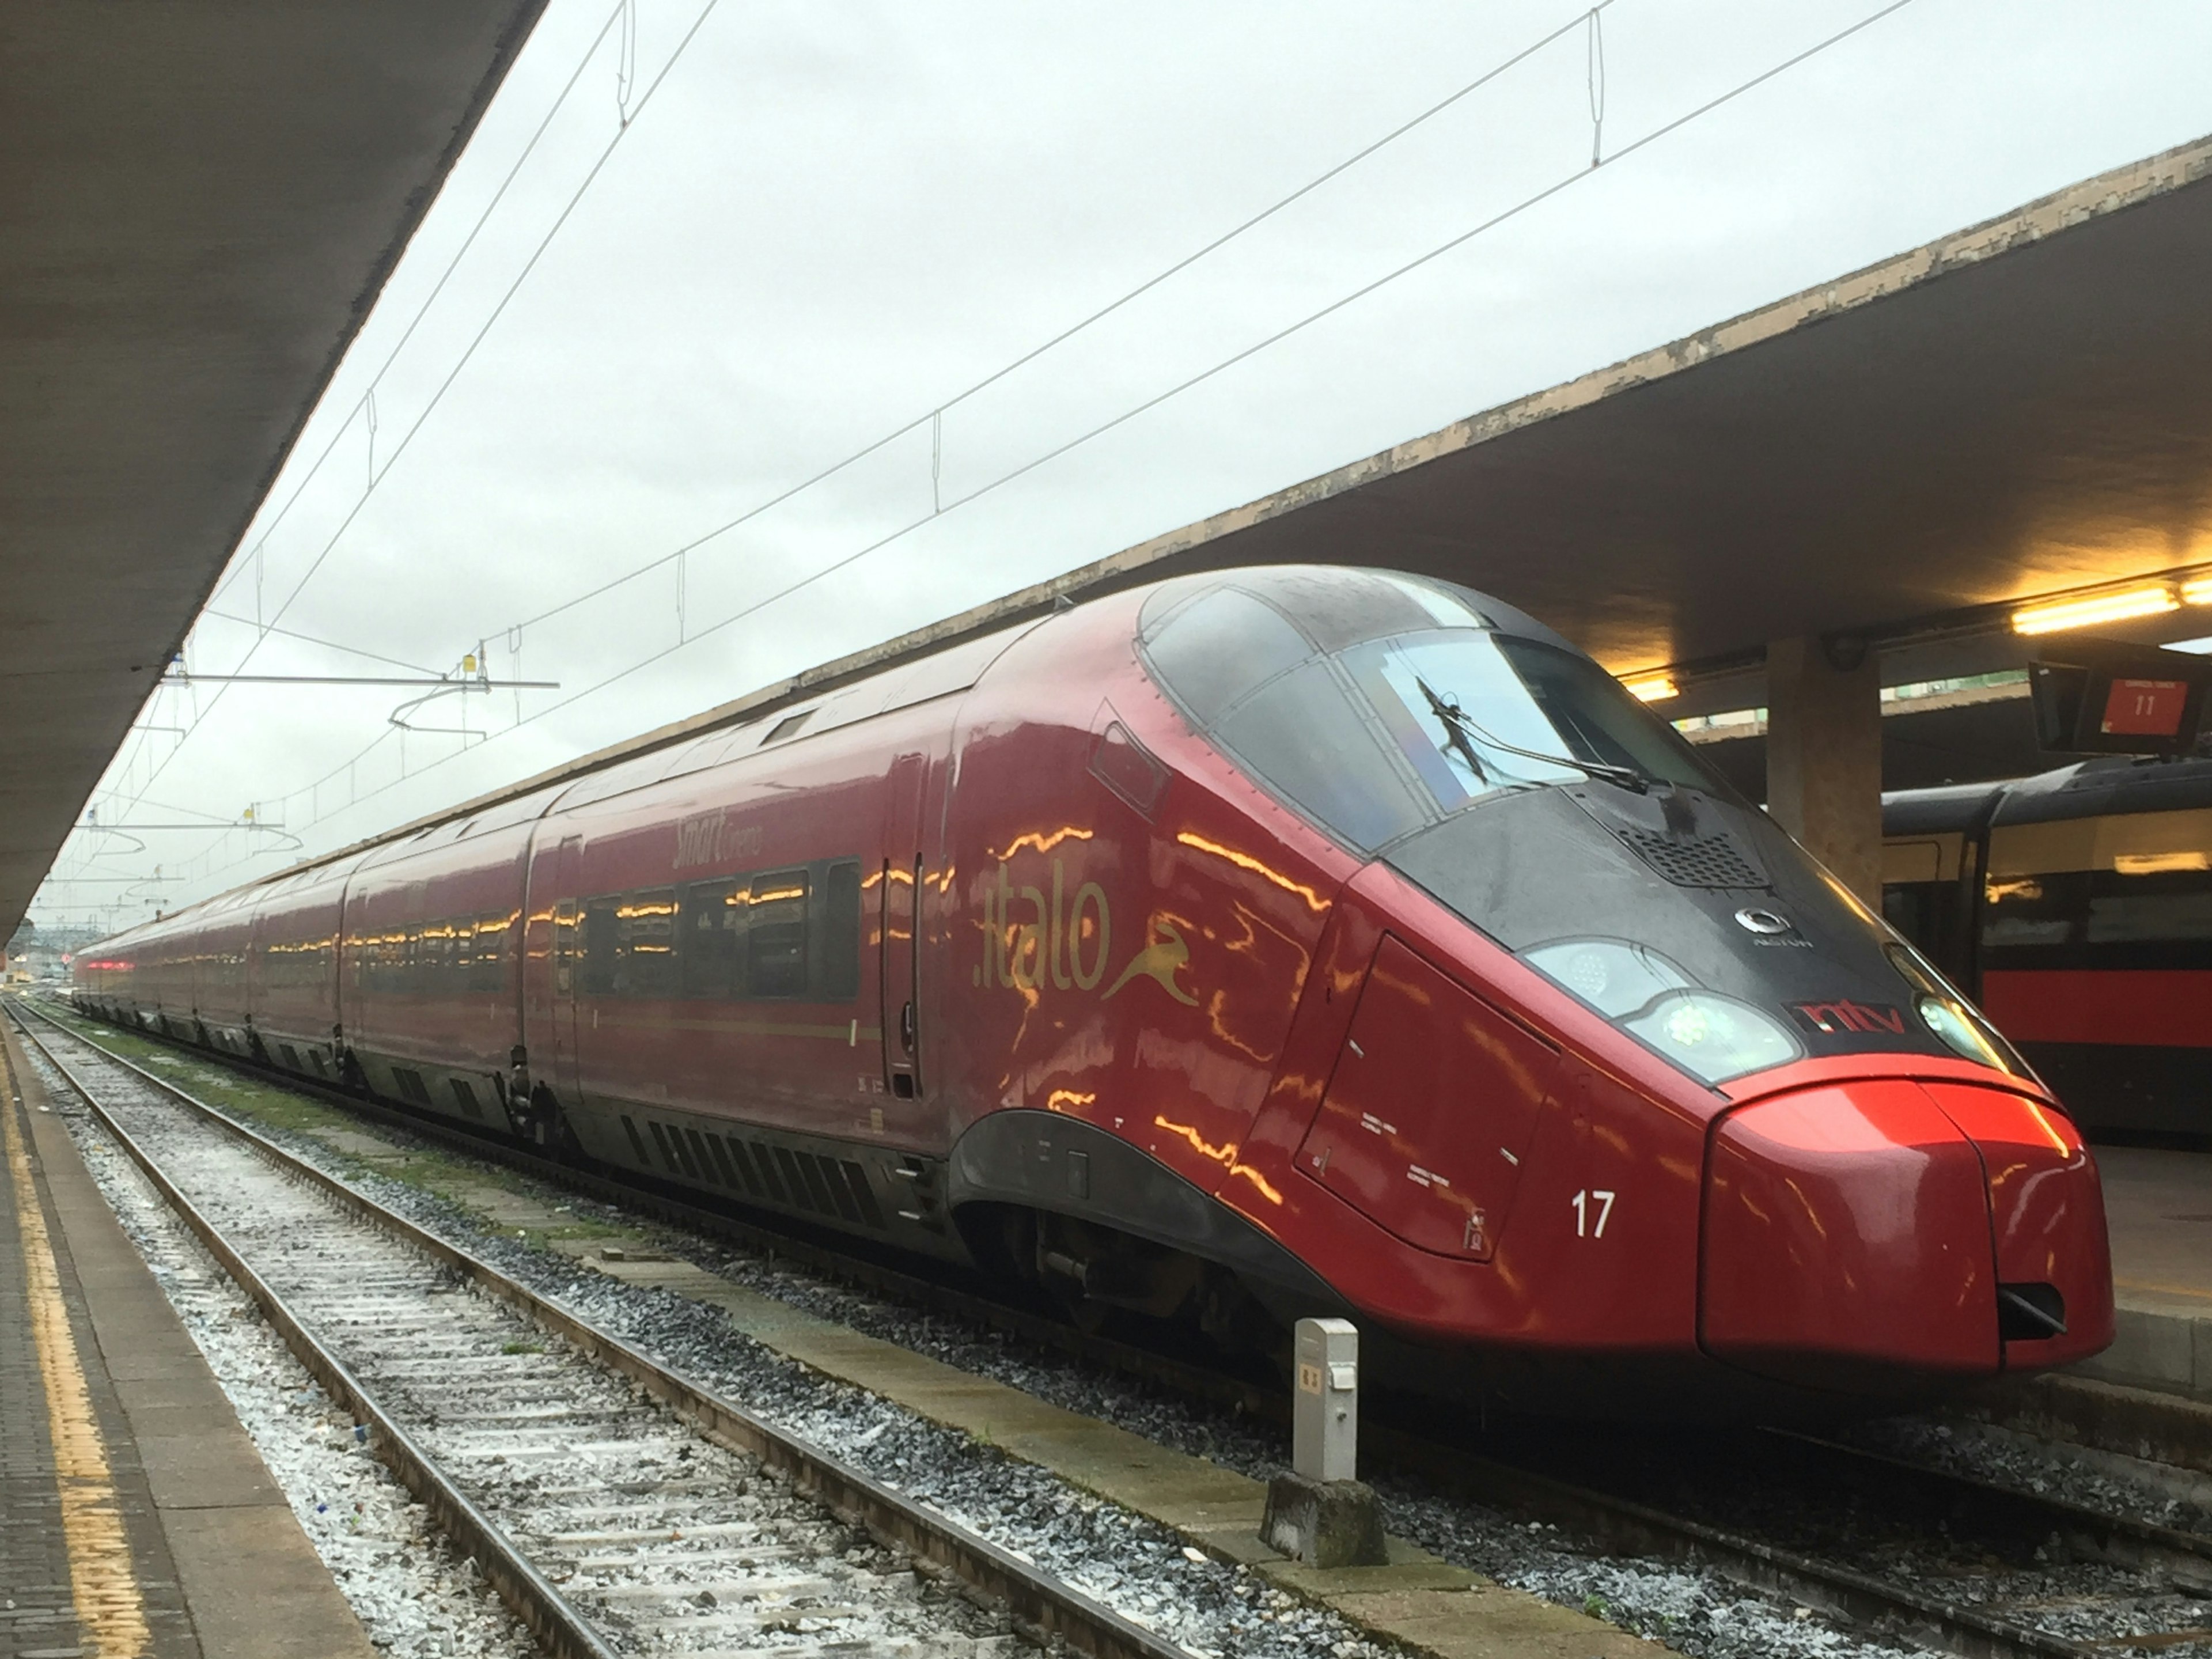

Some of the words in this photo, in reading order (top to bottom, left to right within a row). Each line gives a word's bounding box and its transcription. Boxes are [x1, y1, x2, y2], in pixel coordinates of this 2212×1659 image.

[2135, 695, 2156, 715] 11
[672, 807, 726, 869] Smart
[1794, 998, 1905, 1035] ntv
[1571, 1188, 1616, 1238] 17
